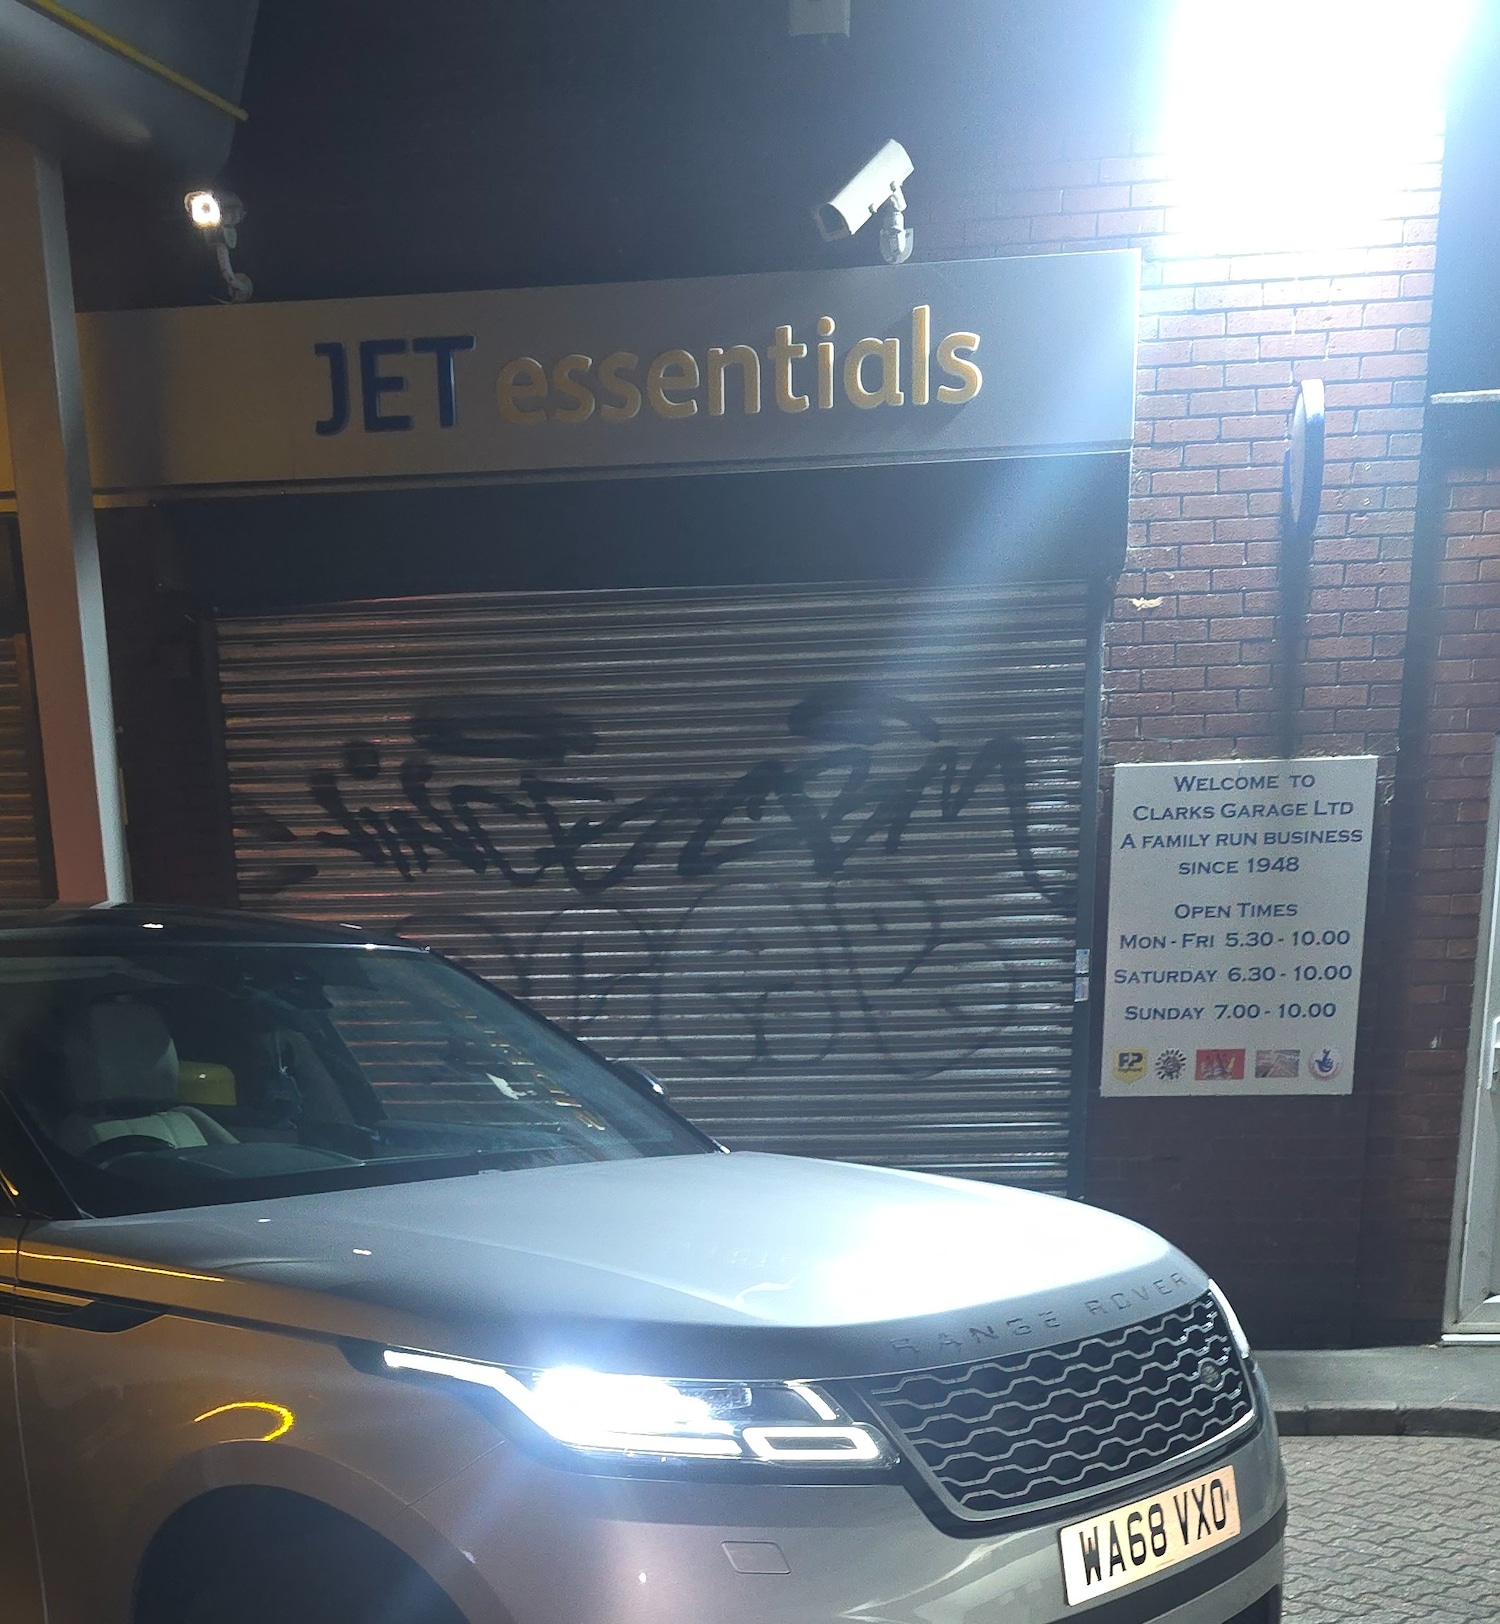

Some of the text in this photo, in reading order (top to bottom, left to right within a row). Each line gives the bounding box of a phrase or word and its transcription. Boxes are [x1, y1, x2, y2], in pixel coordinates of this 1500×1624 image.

[314, 304, 984, 436] JET essentials
[1119, 829, 1363, 850] A FAMILY RUN BUSINESS
[1178, 857, 1300, 875] SINCE 1948
[1224, 932, 1274, 948] 5.30
[1292, 930, 1351, 946] 10.00
[1227, 967, 1276, 983] 6.30
[1294, 965, 1352, 981] 10.00
[1215, 1003, 1260, 1019] 7.00
[1278, 1003, 1337, 1019] 10.00
[890, 1271, 1191, 1353] RANGE ROVER
[1079, 1478, 1226, 1586] WA68 VXO
